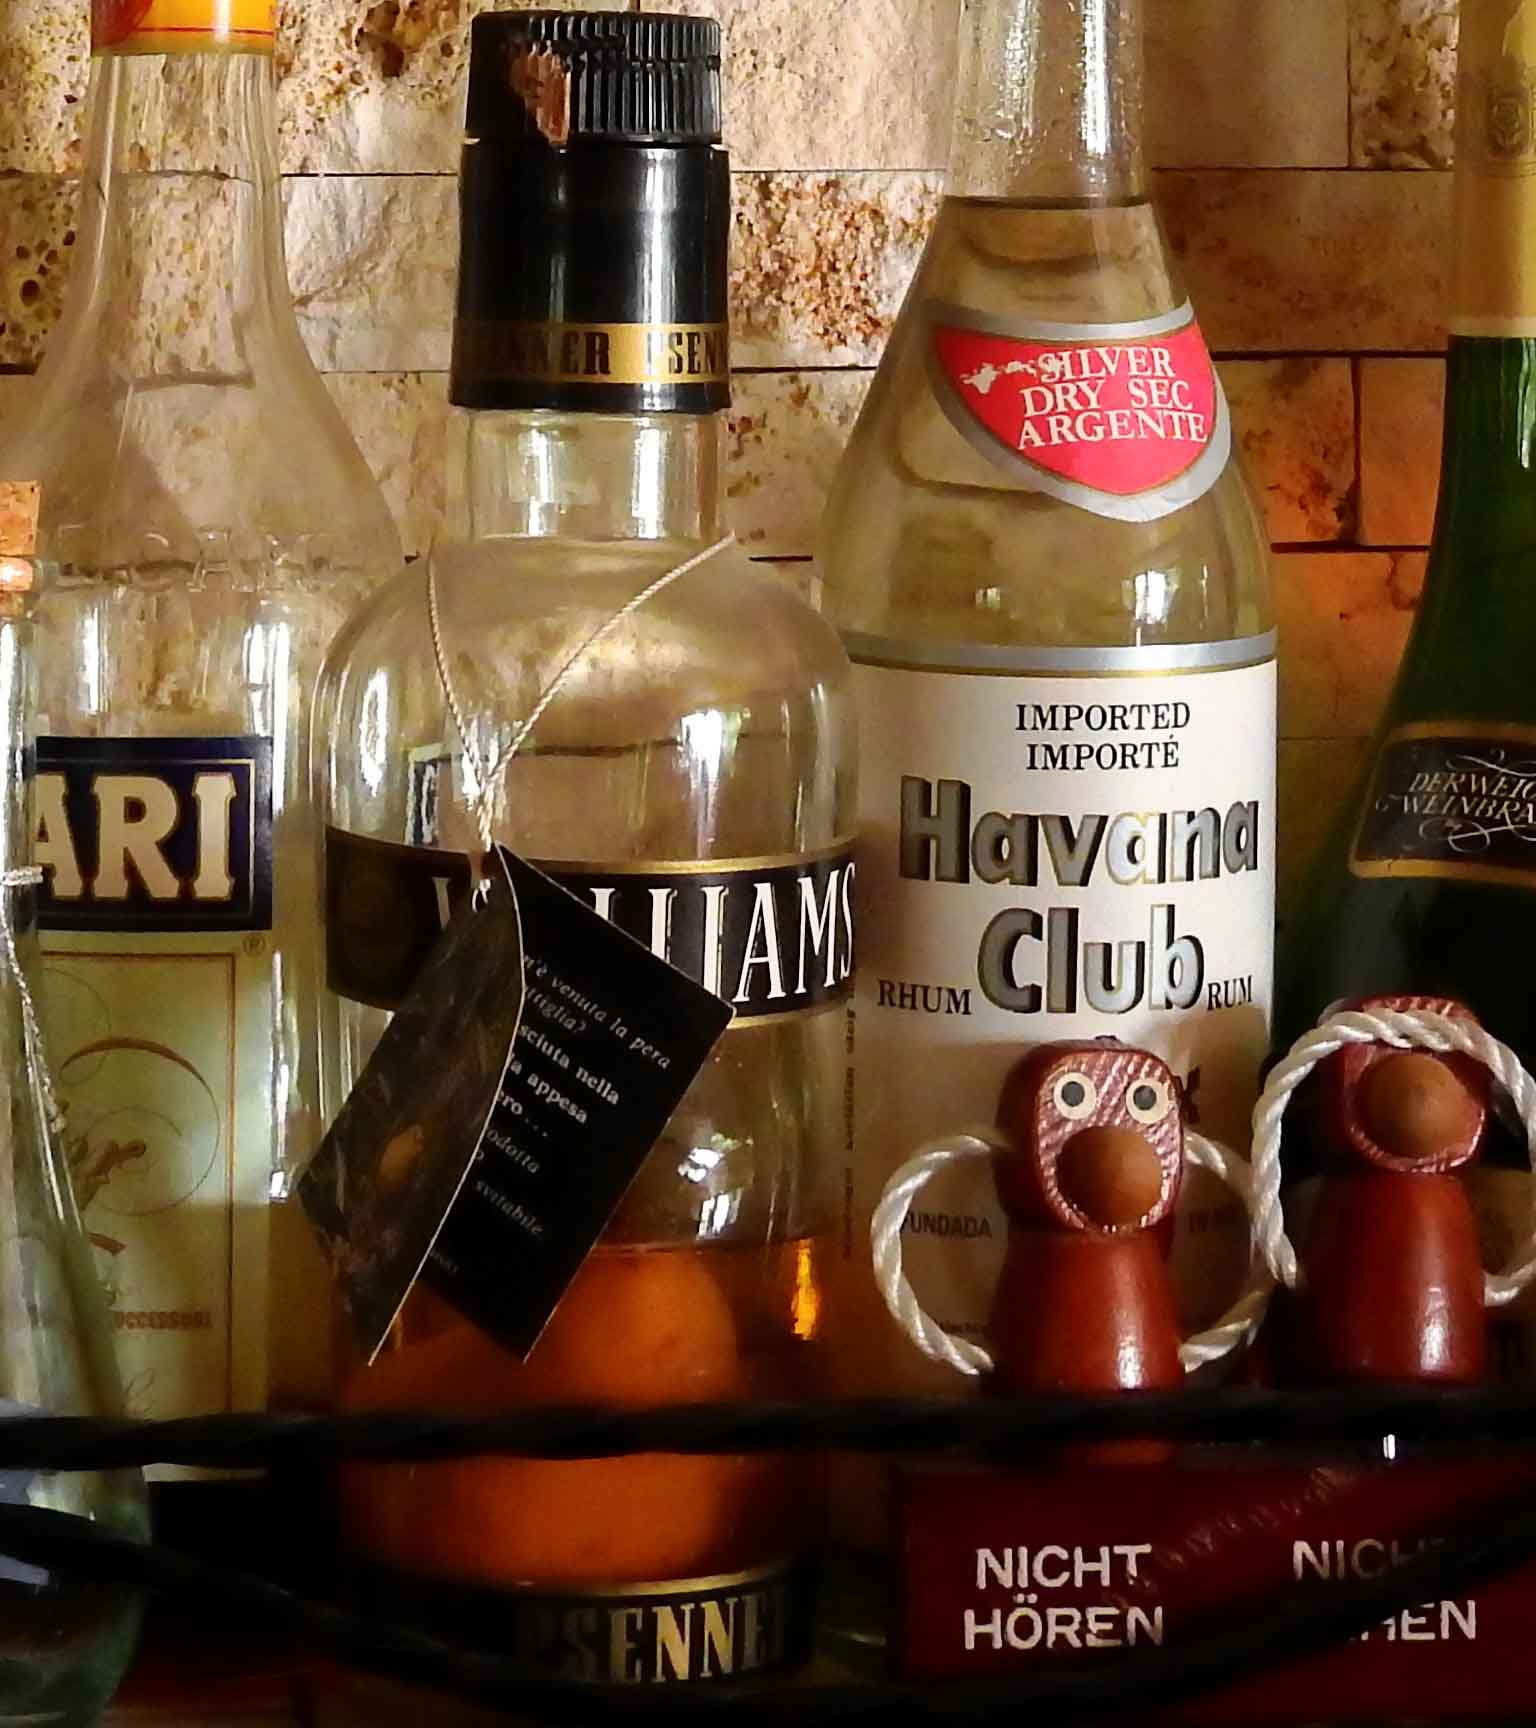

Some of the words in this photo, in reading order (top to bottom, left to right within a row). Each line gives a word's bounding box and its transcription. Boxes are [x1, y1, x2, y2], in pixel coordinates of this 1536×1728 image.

[1040, 347, 1174, 384] SILVER
[1019, 378, 1105, 418] DRY
[1128, 380, 1195, 410] SEC
[1017, 409, 1208, 450] ARGENTE
[1015, 702, 1191, 731] IMPORTED
[1026, 735, 1180, 770] IMPORTÉ
[1408, 771, 1460, 793] DER
[898, 774, 1259, 888] Havana
[976, 902, 1205, 1015] Club
[876, 978, 973, 1017] RHUM
[1206, 975, 1254, 1011] RUM
[551, 976, 607, 1024] venuta
[614, 1017, 631, 1041] la
[628, 1035, 672, 1072] pera
[526, 1071, 589, 1126] appesa
[577, 1063, 622, 1107] nella
[974, 1543, 1152, 1589] NICHT
[963, 1593, 1164, 1650] HÖREN
